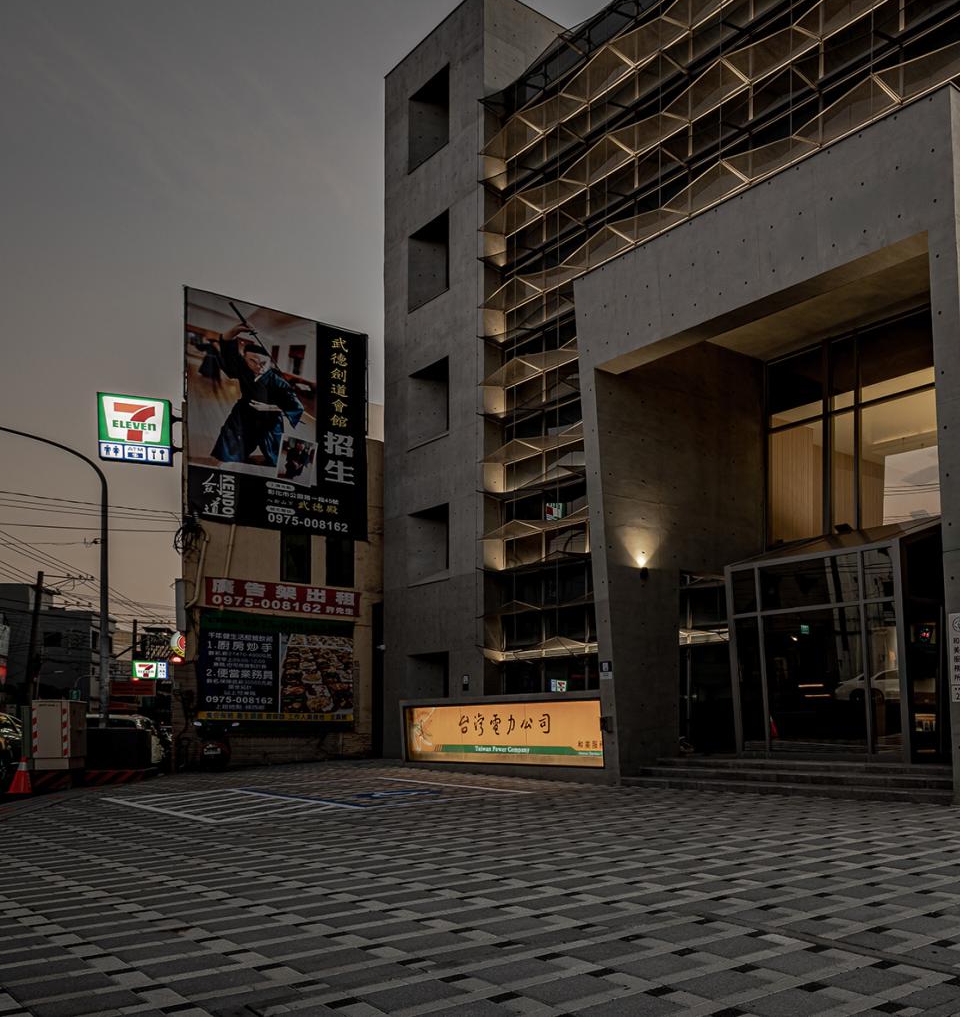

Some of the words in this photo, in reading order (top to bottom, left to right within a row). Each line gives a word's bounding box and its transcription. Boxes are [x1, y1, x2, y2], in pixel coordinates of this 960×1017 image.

[323, 430, 356, 486] 招生
[221, 473, 236, 515] KENDO
[267, 513, 349, 533] 0975-008162
[211, 578, 355, 607] 廣告架出租
[211, 594, 322, 614] 0975-008162
[205, 695, 273, 705] 0975-008162
[507, 746, 530, 754] Company
